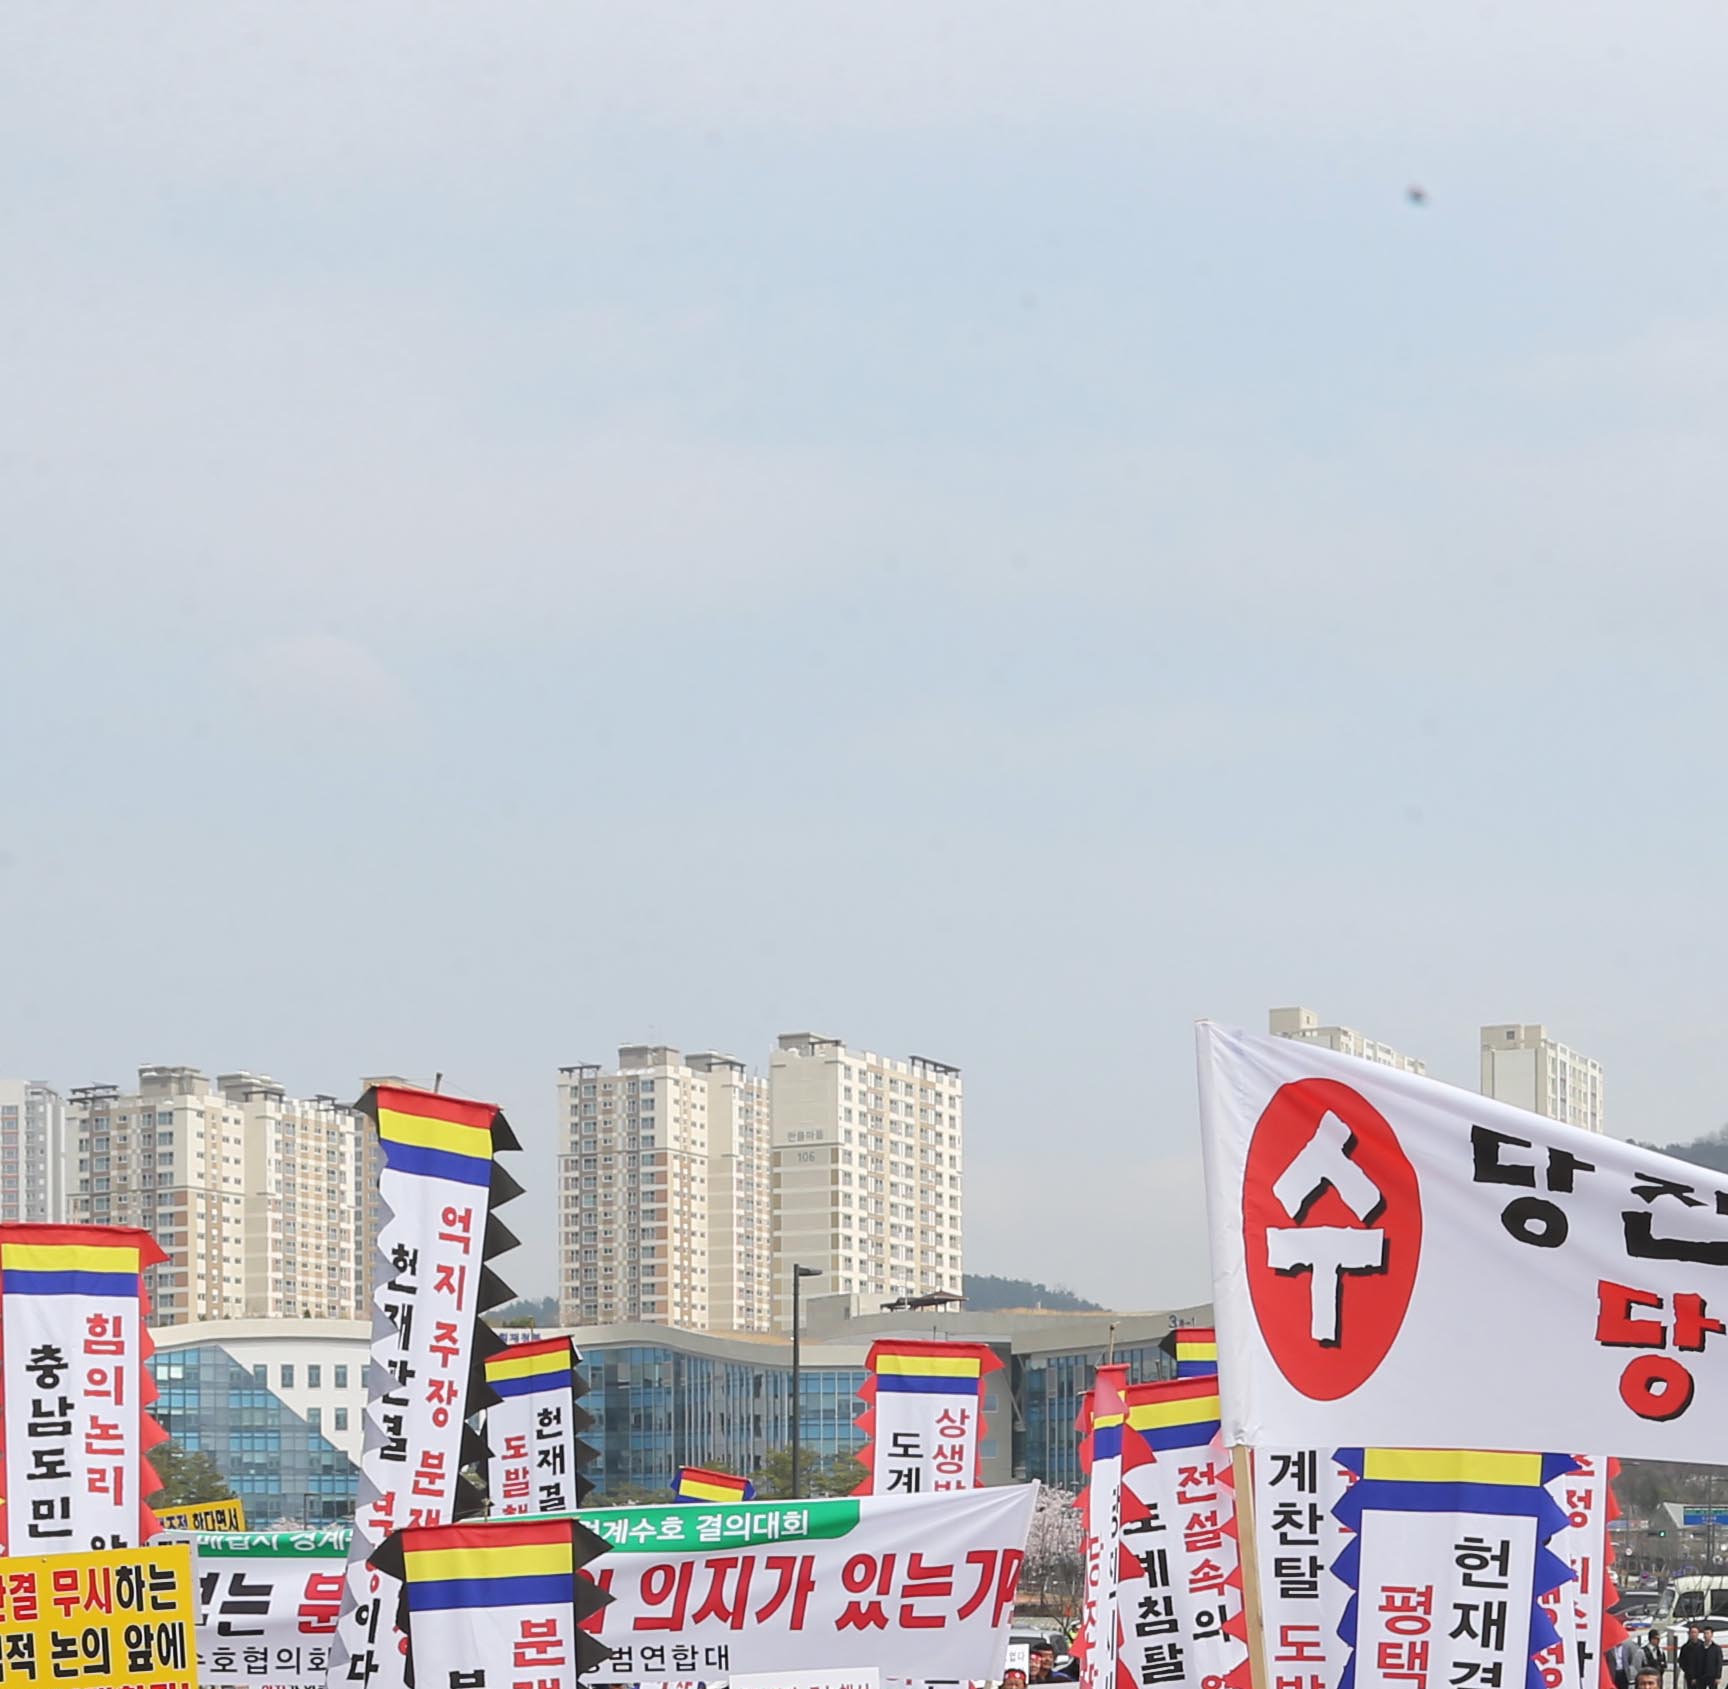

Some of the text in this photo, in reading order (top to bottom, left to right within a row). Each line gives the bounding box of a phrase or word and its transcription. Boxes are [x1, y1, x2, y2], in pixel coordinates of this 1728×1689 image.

[424, 1205, 473, 1428] 억지주장
[1265, 1107, 1385, 1348] 수
[24, 1345, 75, 1538] 충남도민
[81, 1312, 126, 1507] 힘의논리
[50, 1561, 177, 1617] 무시하는
[633, 1555, 815, 1633] 의지가
[695, 1508, 809, 1540] 결의대회
[1176, 1462, 1231, 1643] 전설속의
[50, 1630, 110, 1679] 논의
[122, 1619, 188, 1670] 앞에
